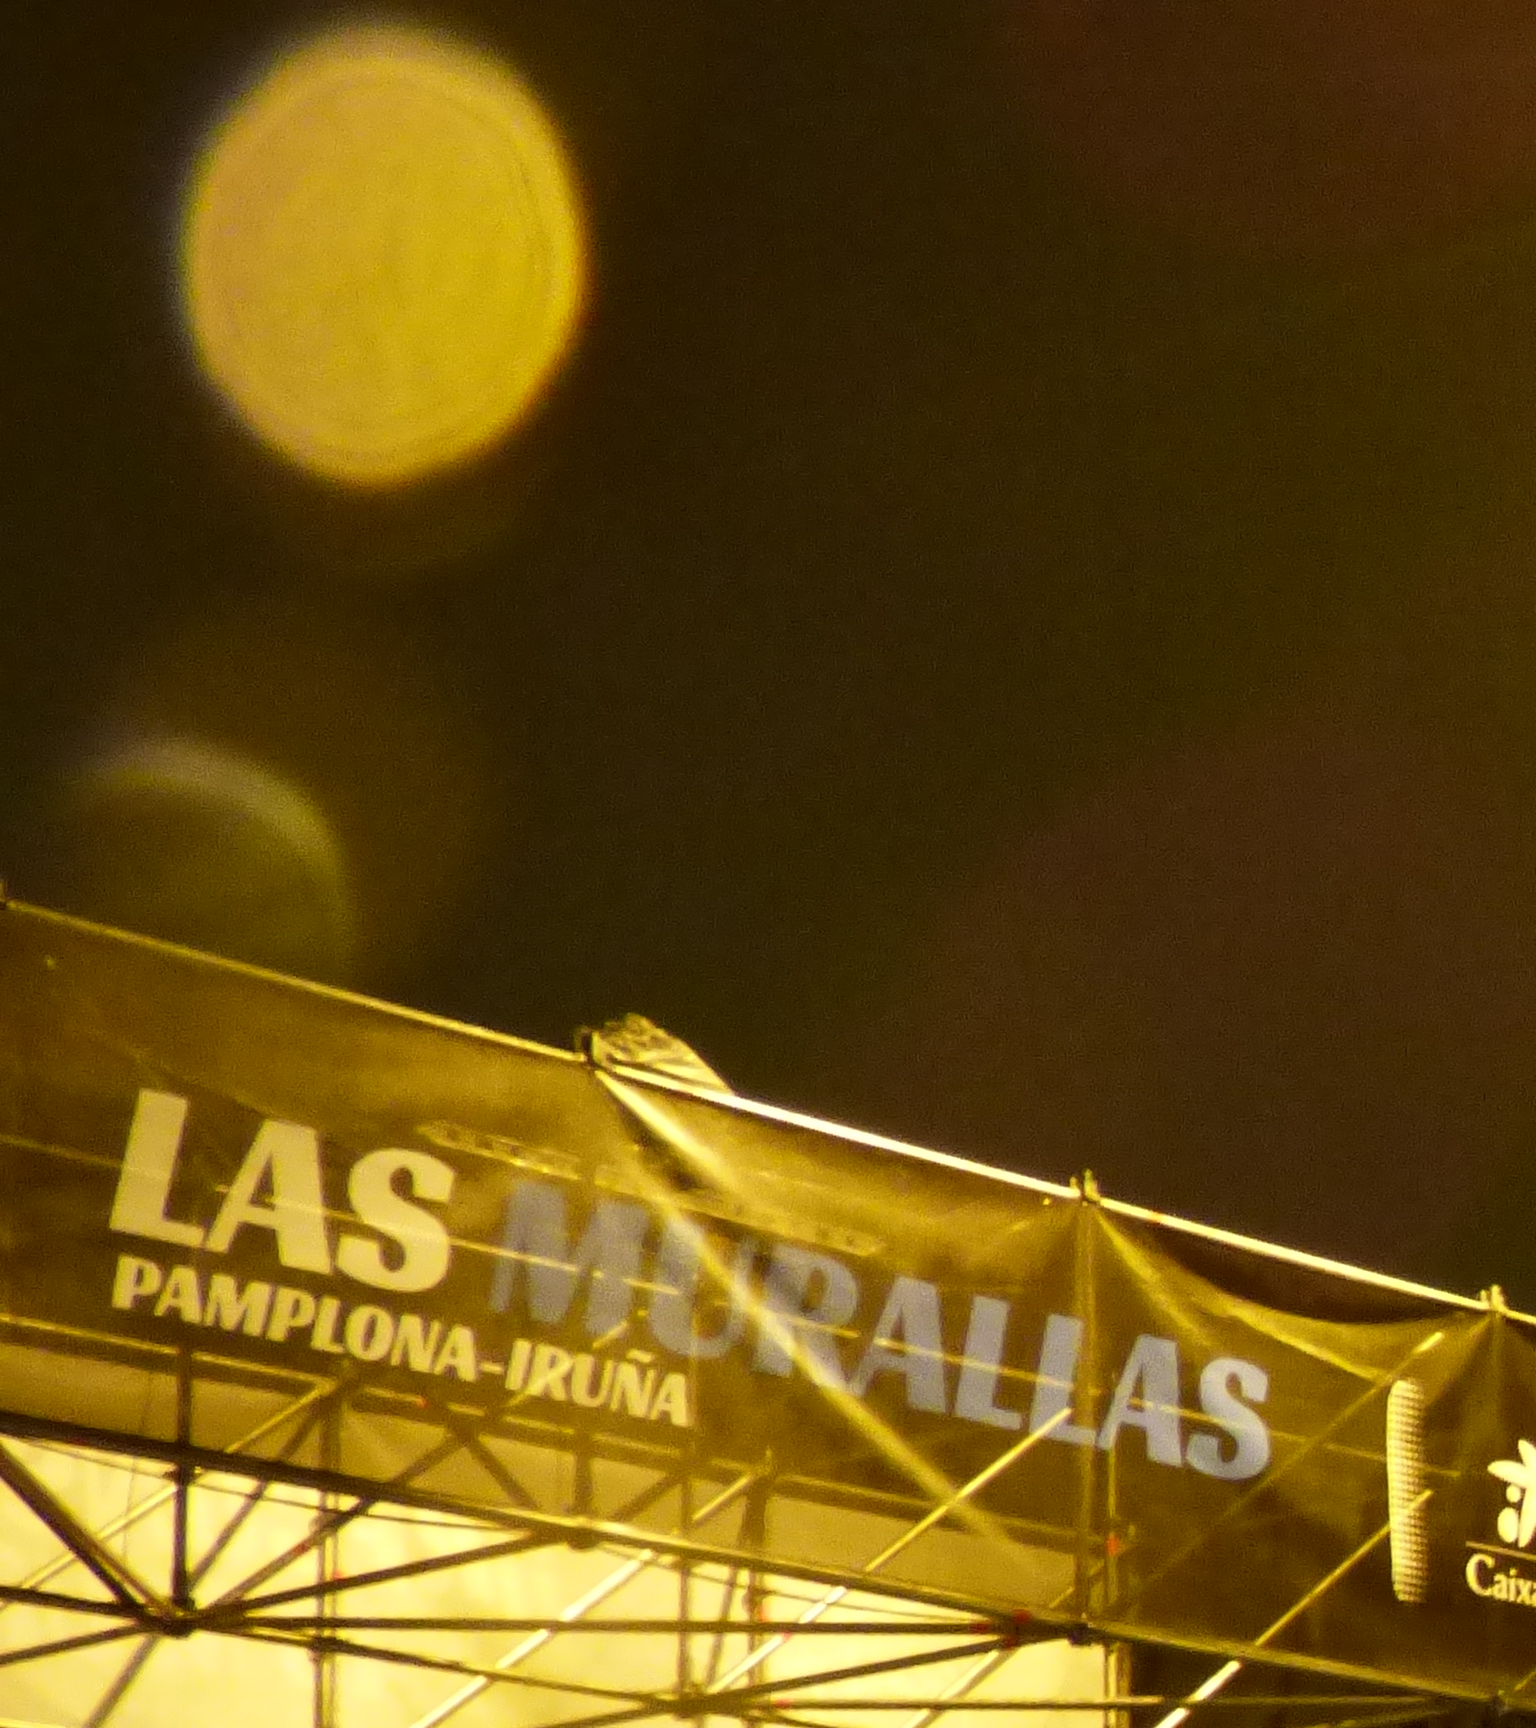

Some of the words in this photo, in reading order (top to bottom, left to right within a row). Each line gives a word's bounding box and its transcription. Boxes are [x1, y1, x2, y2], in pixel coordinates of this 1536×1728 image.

[109, 1088, 458, 1293] LAS
[490, 1180, 1271, 1481] MURALLAS
[110, 1254, 692, 1428] PAMPLONA-IRUÑA
